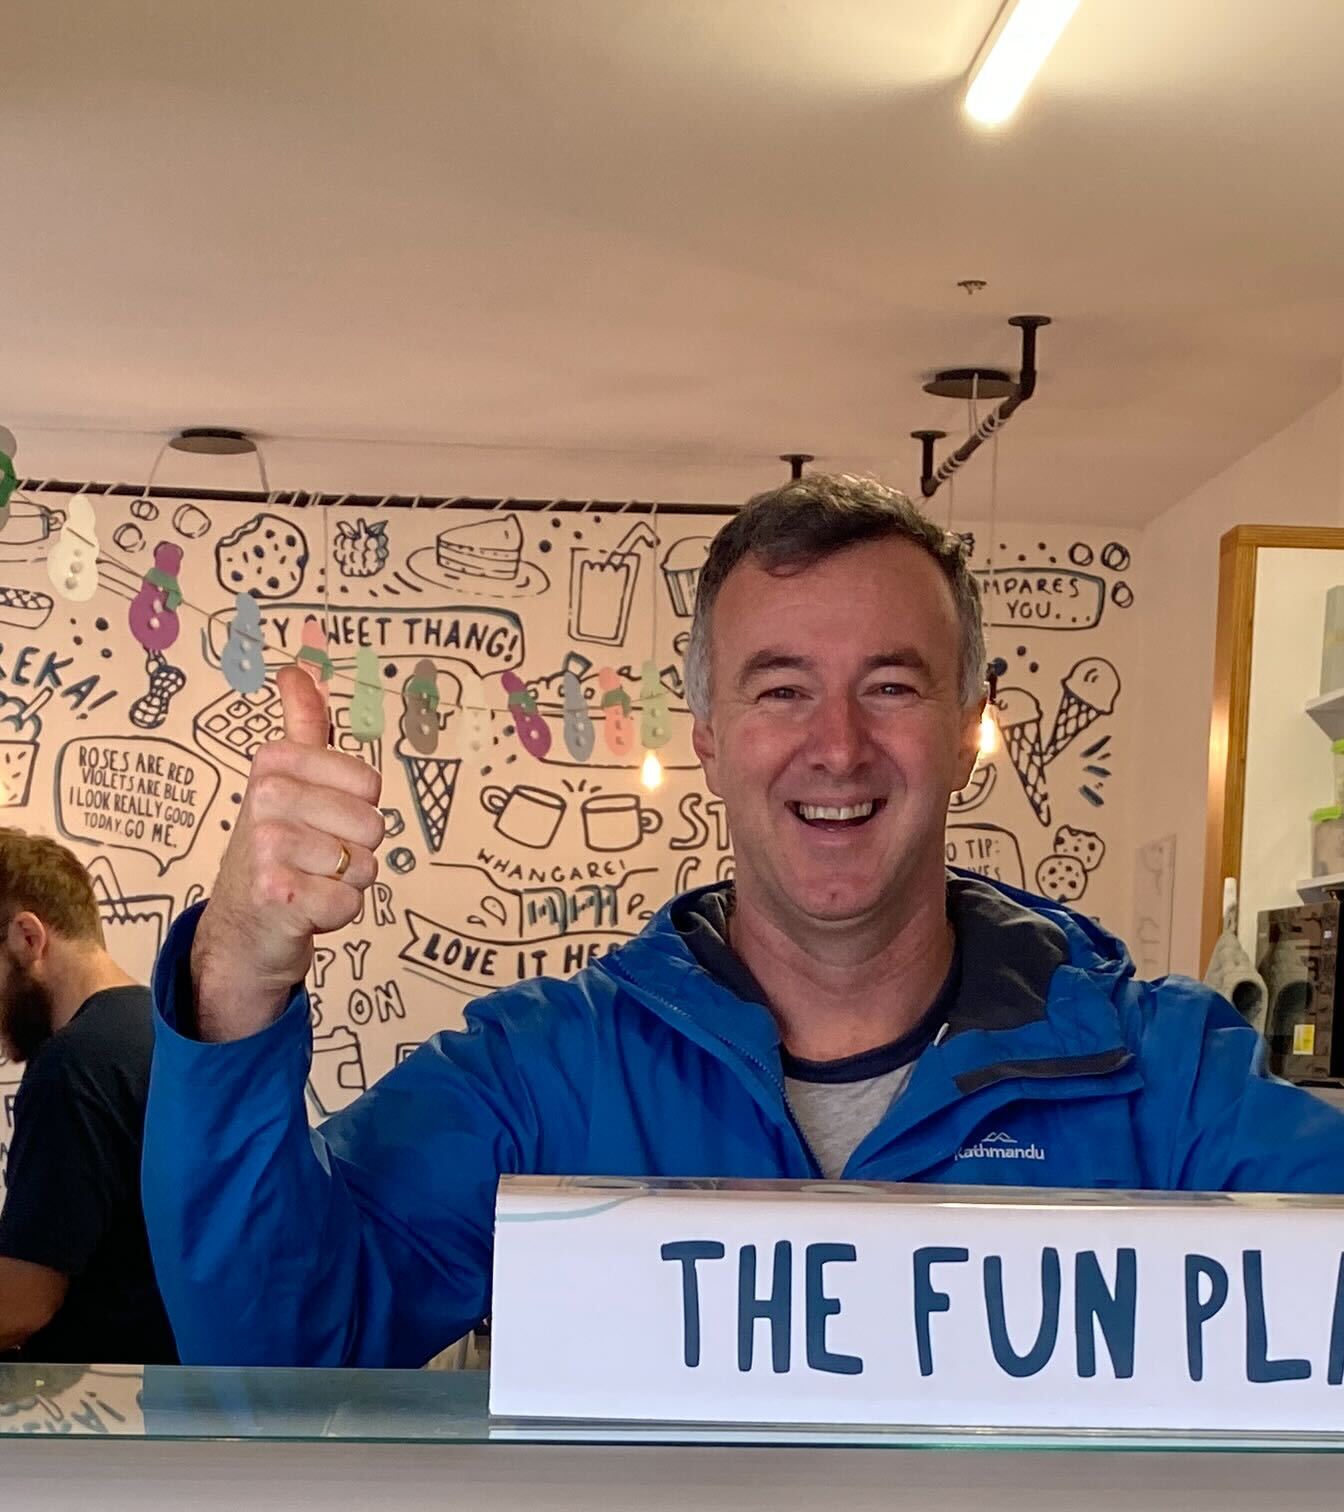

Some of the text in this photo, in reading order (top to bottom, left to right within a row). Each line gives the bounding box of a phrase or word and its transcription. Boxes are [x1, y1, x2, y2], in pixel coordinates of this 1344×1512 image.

[304, 614, 392, 647] WEET
[407, 616, 519, 663] THANG!
[79, 746, 195, 786] ROSES ARE RED
[82, 768, 197, 806] VIOLETS ARE BLUE
[77, 787, 195, 828] LOOK REALLY GOOD
[124, 818, 145, 841] GO
[151, 823, 177, 848] ME.
[477, 848, 626, 883] WHANGAREI
[424, 933, 549, 979] LOVE IT
[660, 1239, 864, 1376] THE
[912, 1246, 1137, 1379] FUN
